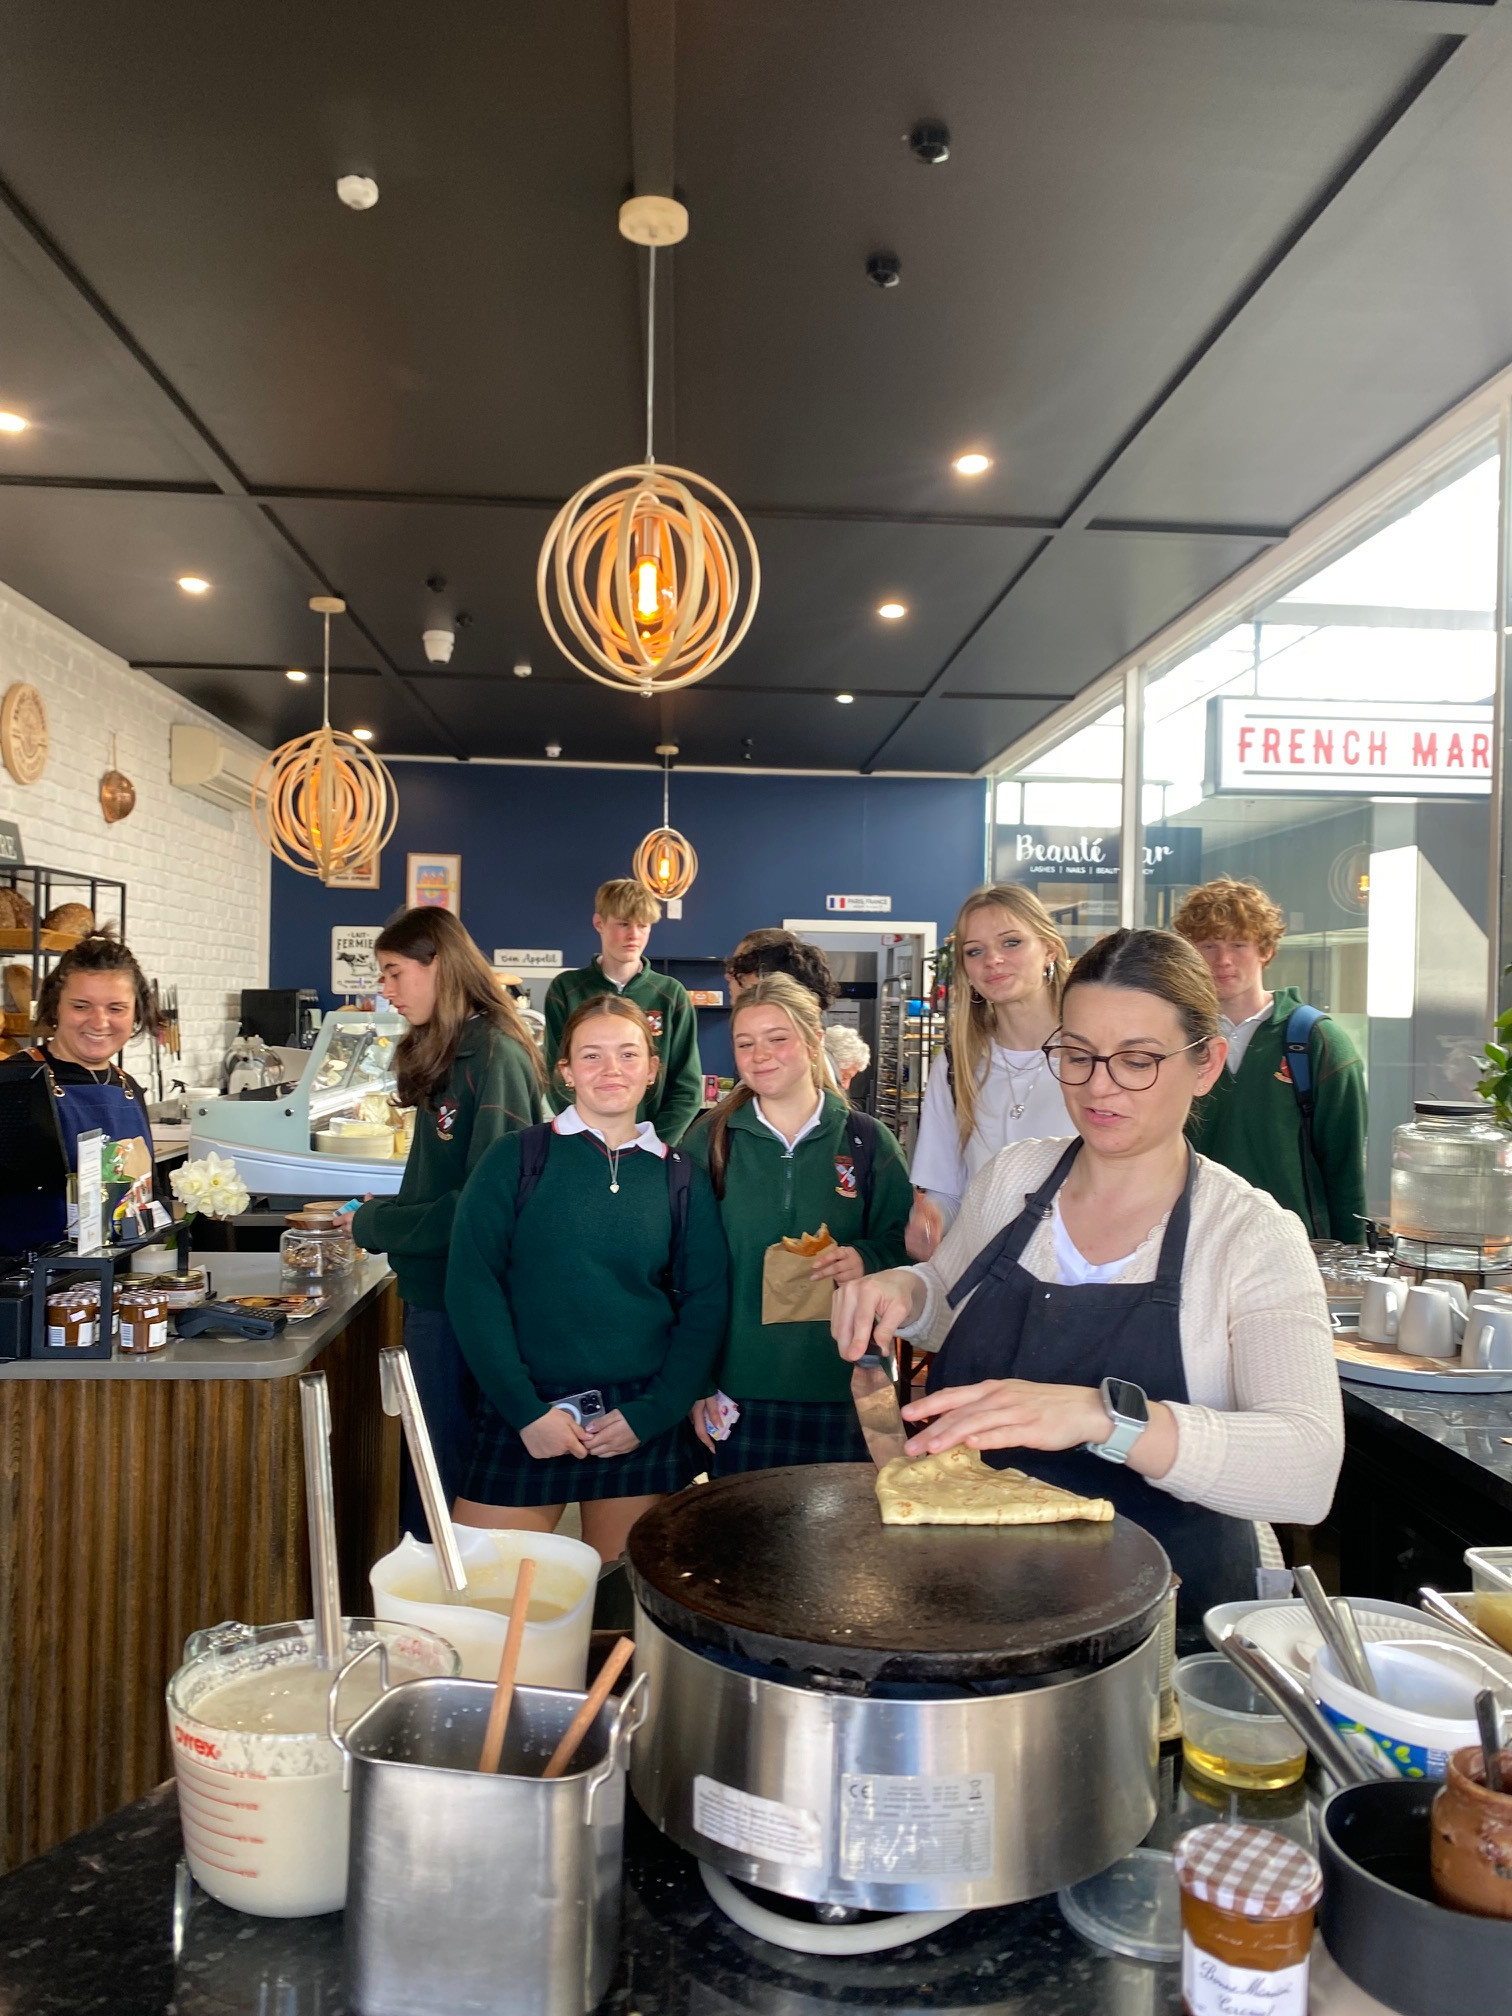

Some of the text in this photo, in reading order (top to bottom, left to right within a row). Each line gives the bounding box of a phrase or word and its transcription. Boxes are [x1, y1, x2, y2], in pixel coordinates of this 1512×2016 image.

[1238, 727, 1490, 768] FRENCH MAR
[1016, 834, 1174, 865] Beauté ar
[337, 939, 375, 950] FERMIE
